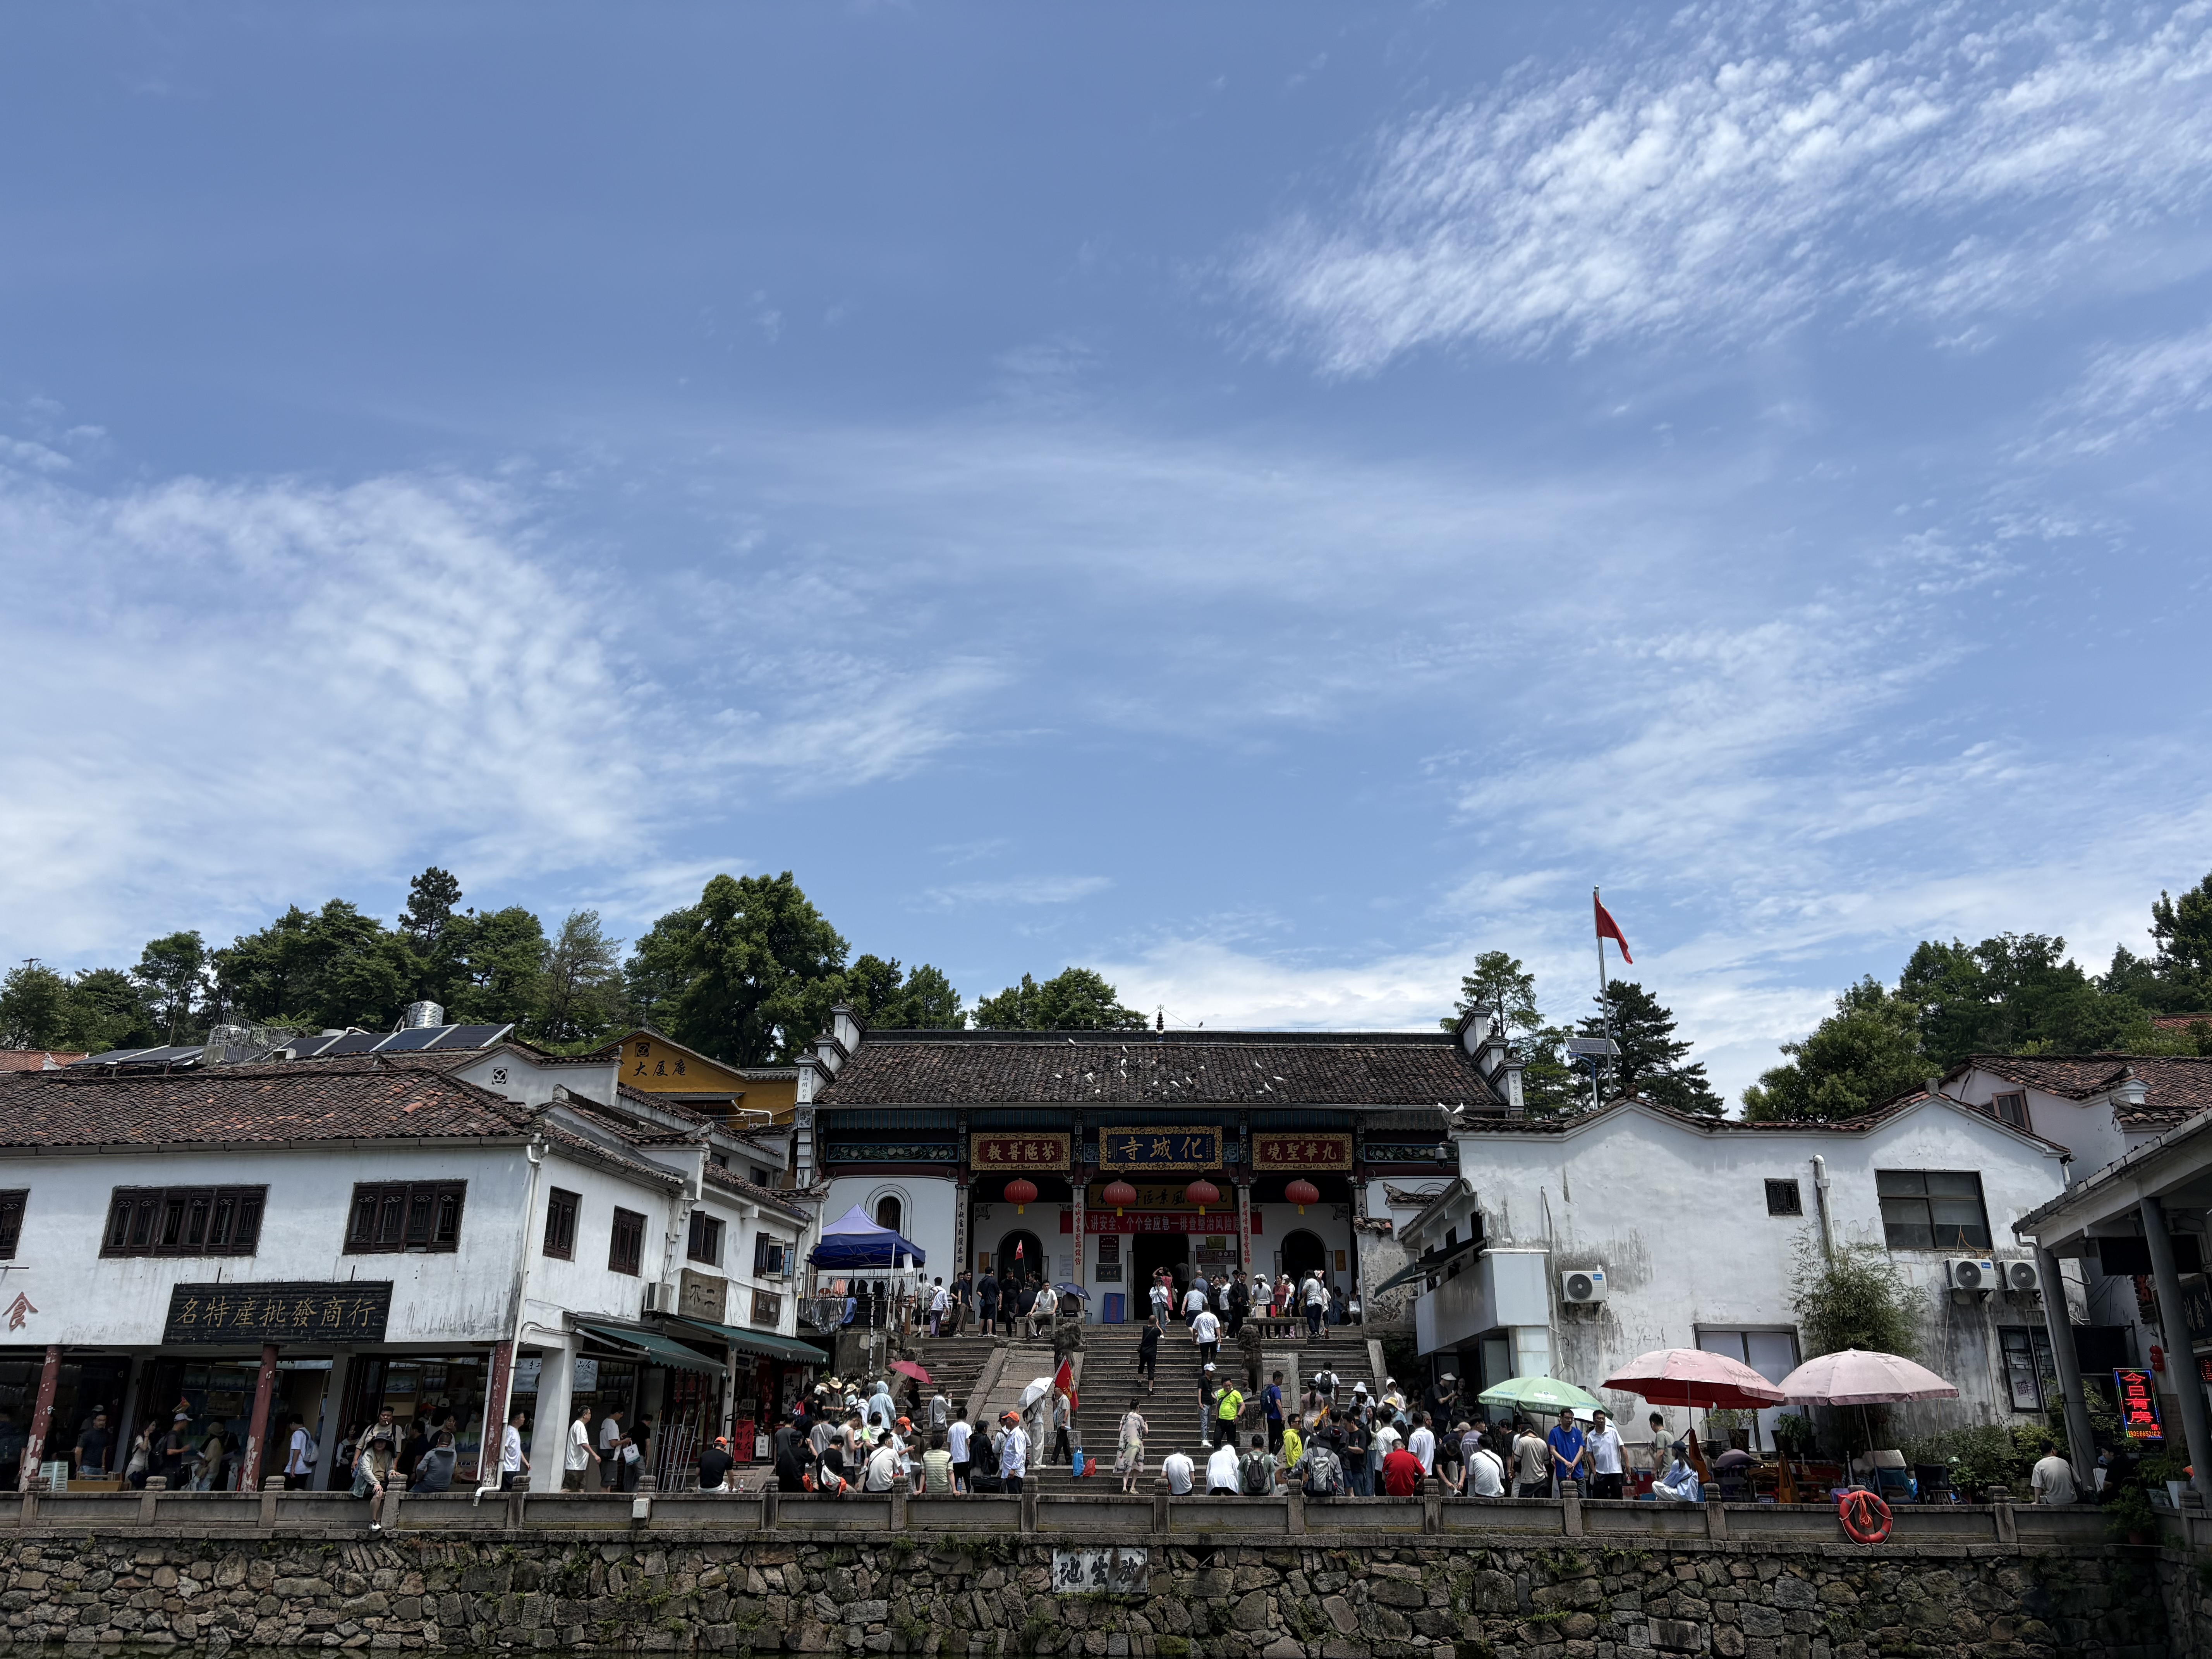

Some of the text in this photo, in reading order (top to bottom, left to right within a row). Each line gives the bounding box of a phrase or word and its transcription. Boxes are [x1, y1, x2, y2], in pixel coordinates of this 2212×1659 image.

[1119, 1136, 1203, 1160] 化城寺
[2, 1291, 38, 1331] 食
[2123, 1372, 2153, 1423] 今日有房
